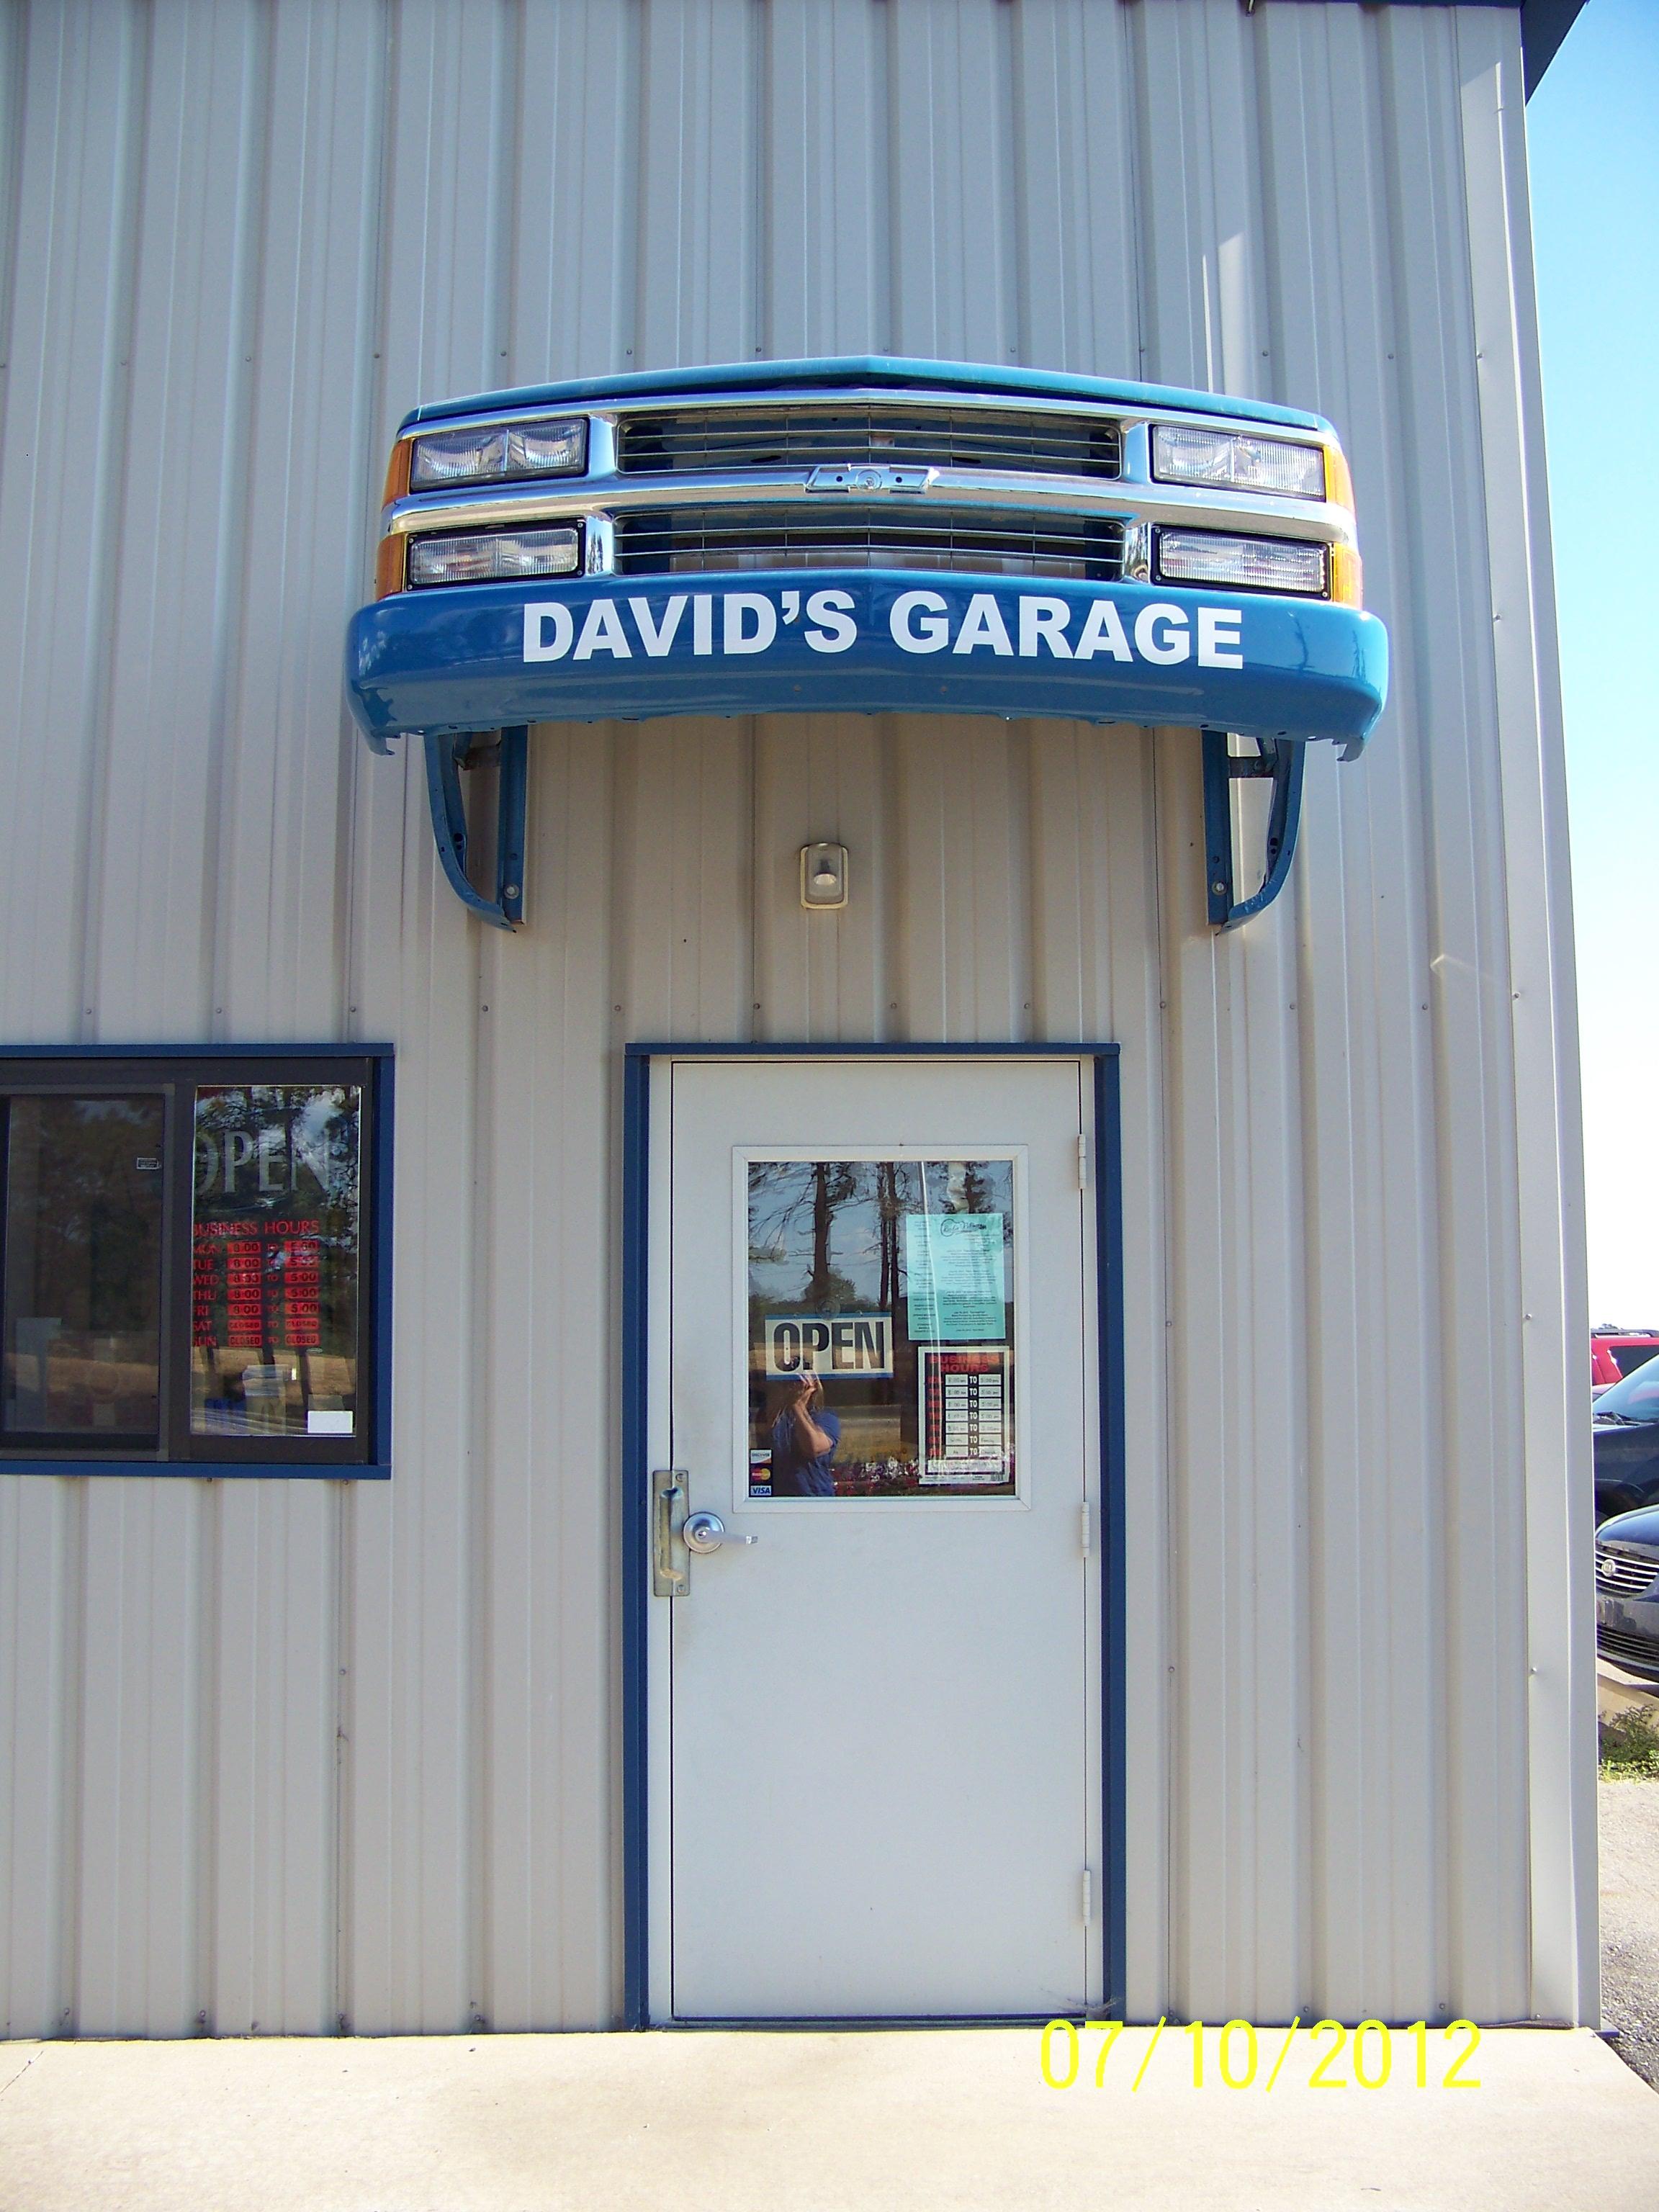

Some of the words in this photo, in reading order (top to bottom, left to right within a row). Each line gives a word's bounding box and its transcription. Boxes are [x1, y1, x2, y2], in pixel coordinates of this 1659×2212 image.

[522, 592, 857, 662] DAVID'S
[889, 592, 1244, 670] GARAGE
[264, 1220, 319, 1234] HOURS
[230, 1336, 260, 1345] CLOSED
[773, 1322, 885, 1372] OPEN
[930, 1355, 999, 1364] BUSINESS
[940, 1364, 989, 1372] HOURS
